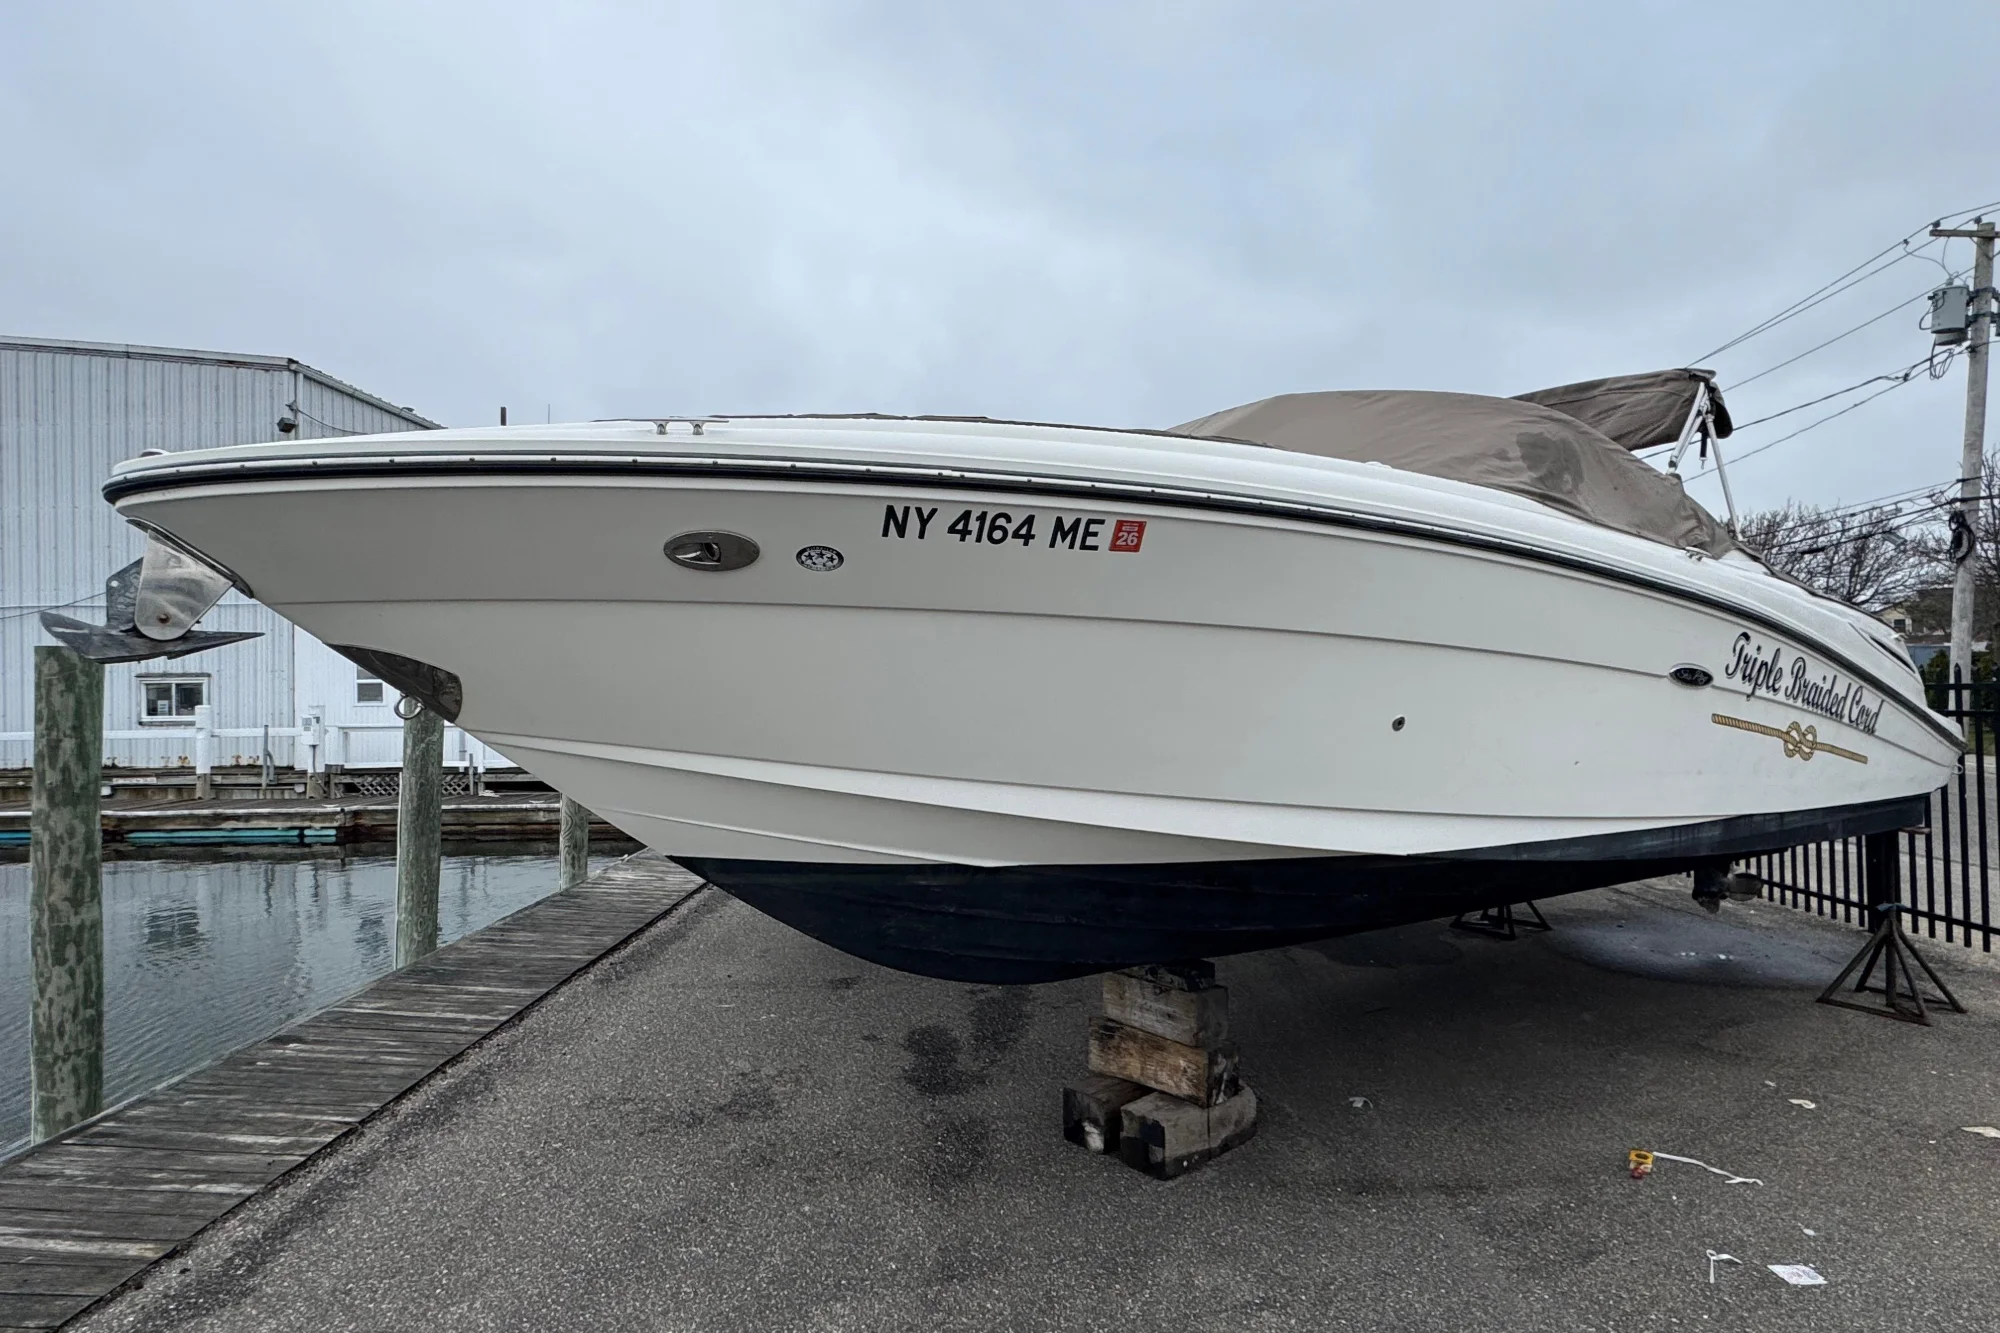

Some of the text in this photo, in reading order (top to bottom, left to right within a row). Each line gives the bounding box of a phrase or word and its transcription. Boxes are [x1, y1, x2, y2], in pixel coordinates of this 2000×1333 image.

[882, 504, 1106, 551] NY 4164 ME
[1115, 531, 1139, 546] 26
[1725, 631, 1884, 735] Triple Braided Cord
